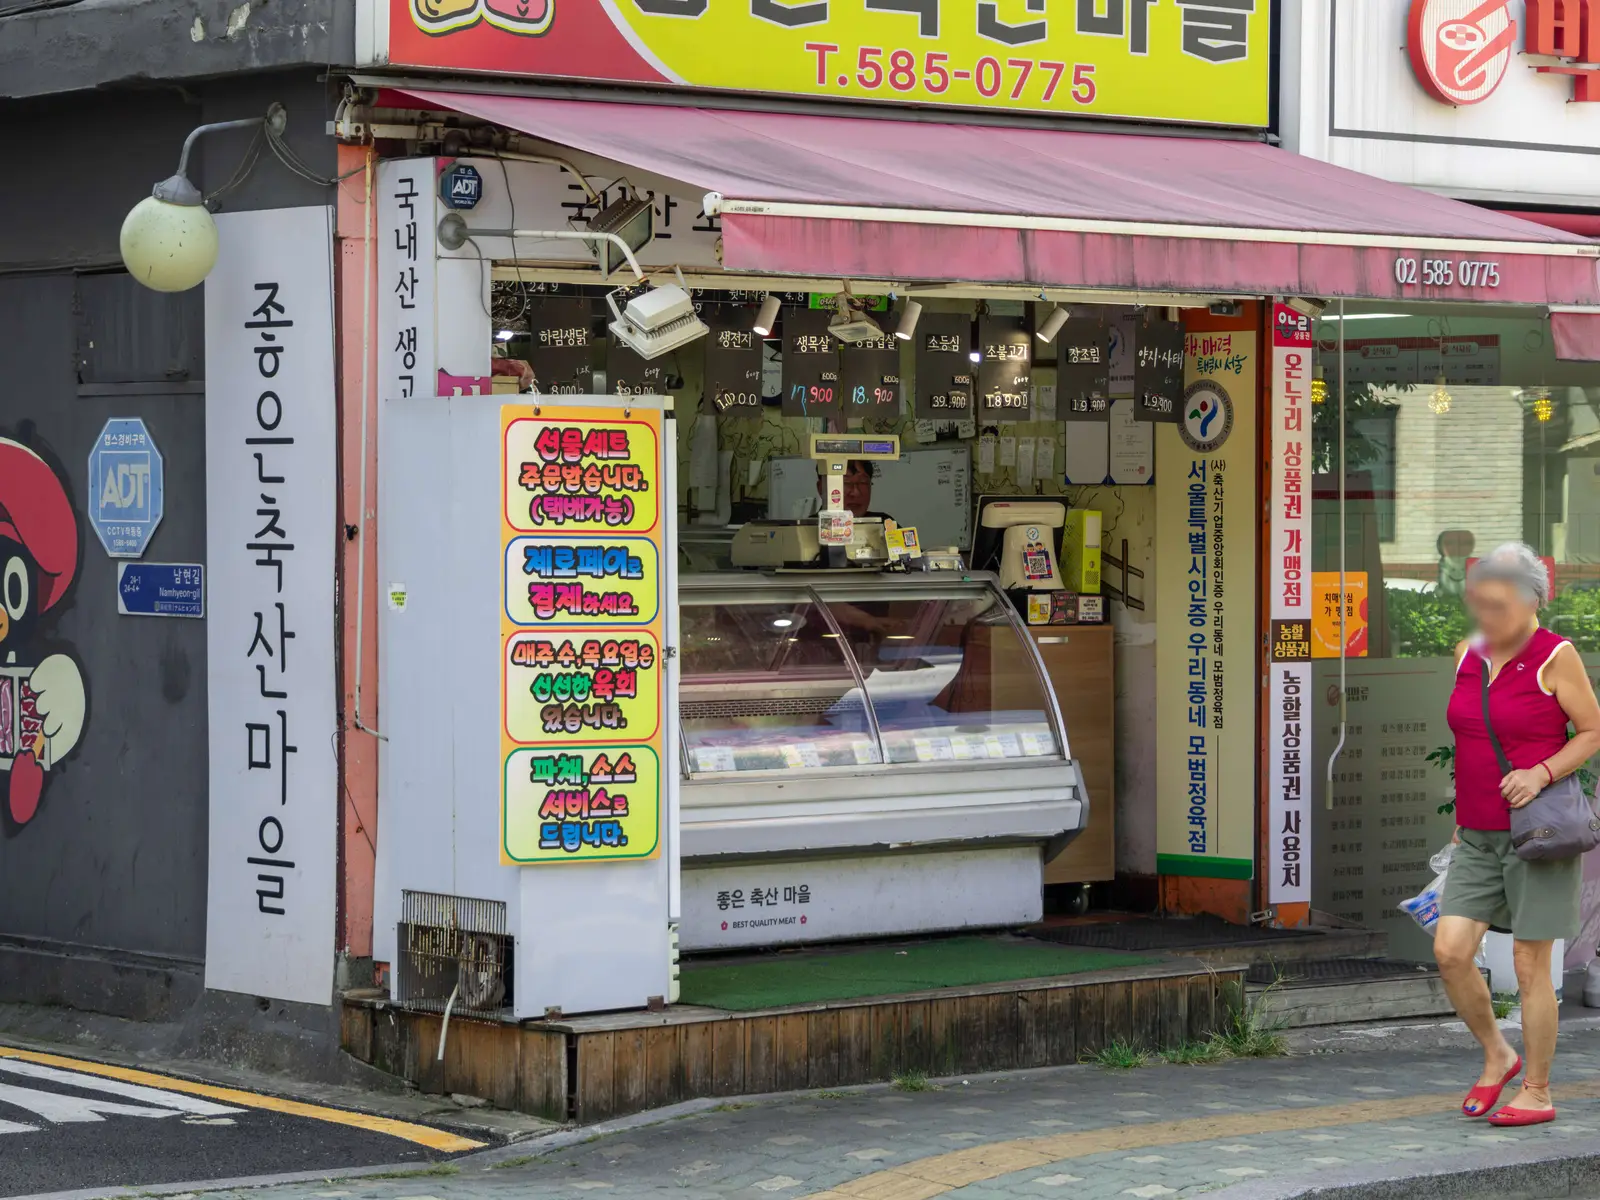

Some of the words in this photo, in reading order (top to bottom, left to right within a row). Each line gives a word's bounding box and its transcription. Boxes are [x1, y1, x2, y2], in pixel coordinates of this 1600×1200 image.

[805, 43, 1097, 104] T.585-0775
[452, 178, 477, 195] ADT
[394, 178, 419, 309] 국내산
[1395, 258, 1417, 285] 02
[1422, 260, 1453, 287] 585
[1458, 261, 1500, 288] 0775
[539, 327, 588, 346] 하림생닭
[719, 331, 752, 348] 생전지
[796, 335, 830, 353] 생목살
[927, 334, 960, 352] 소등심
[986, 344, 1028, 361] 소불고기
[1068, 347, 1100, 363] 장조림
[1196, 356, 1222, 375] 특별시
[1223, 354, 1248, 375] 서울
[1284, 353, 1302, 432] 온누리
[103, 434, 146, 447] 캡스경비구역
[534, 427, 630, 462] 선물세트
[101, 463, 149, 509] ADT
[1283, 441, 1302, 520] 상품권
[529, 494, 635, 526] (택배가능)
[1187, 459, 1208, 627] 서울특별시인증
[173, 568, 200, 584] 남현길
[523, 545, 644, 579] 제로페이로
[1282, 529, 1302, 607] 가맹점
[159, 587, 200, 600] Namhyeon-gil
[528, 581, 639, 620] 결제하세요.
[1324, 592, 1353, 604] 치매심
[1213, 601, 1224, 657] 우리동네
[1280, 624, 1304, 640] 농할
[1274, 641, 1309, 657] 상품권
[1187, 632, 1208, 728] 우리동네
[1213, 660, 1224, 729] 모범정육점
[540, 702, 628, 734] 있습니다.
[538, 787, 629, 820] 서비스로
[1187, 735, 1208, 853] 모범정육점
[539, 820, 628, 853] 드립니다.
[1281, 810, 1302, 887] 사용처
[716, 889, 745, 911] 좋은
[750, 887, 778, 907] 축산
[783, 884, 811, 904] 마을
[732, 920, 748, 929] BEST
[749, 918, 778, 928] QUALITY
[778, 916, 797, 925] MEAT
